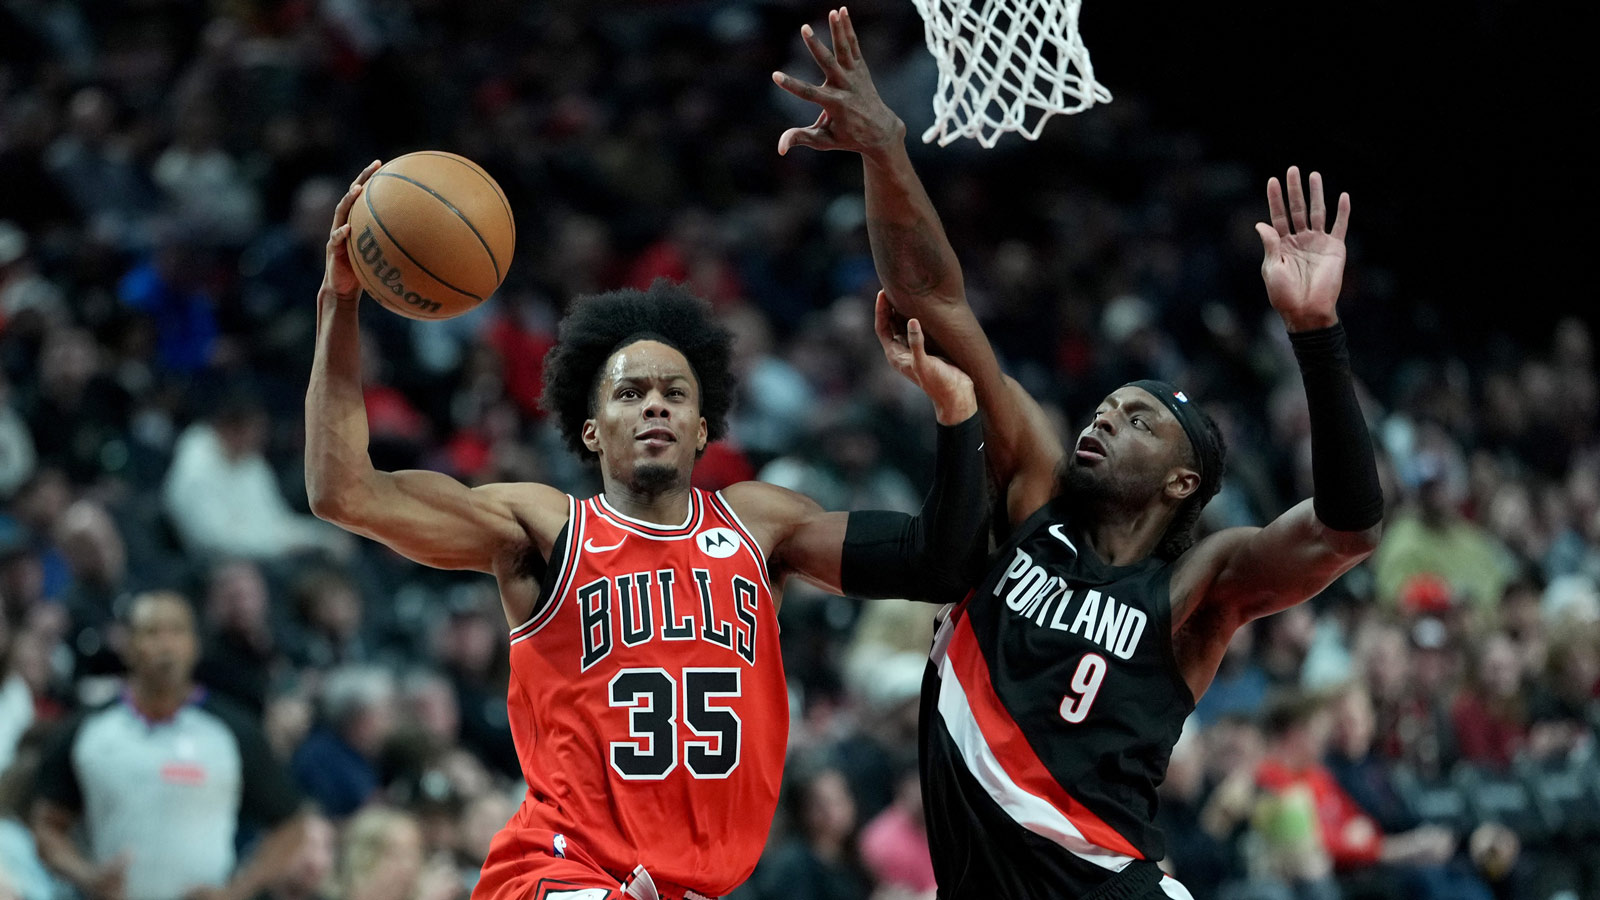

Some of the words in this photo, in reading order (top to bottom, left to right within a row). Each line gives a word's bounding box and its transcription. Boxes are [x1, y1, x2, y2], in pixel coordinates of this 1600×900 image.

[357, 224, 443, 313] Wilson
[577, 568, 758, 673] BULLS
[992, 547, 1148, 660] PORTLAND
[608, 667, 742, 780] 35
[1059, 652, 1108, 723] 9
